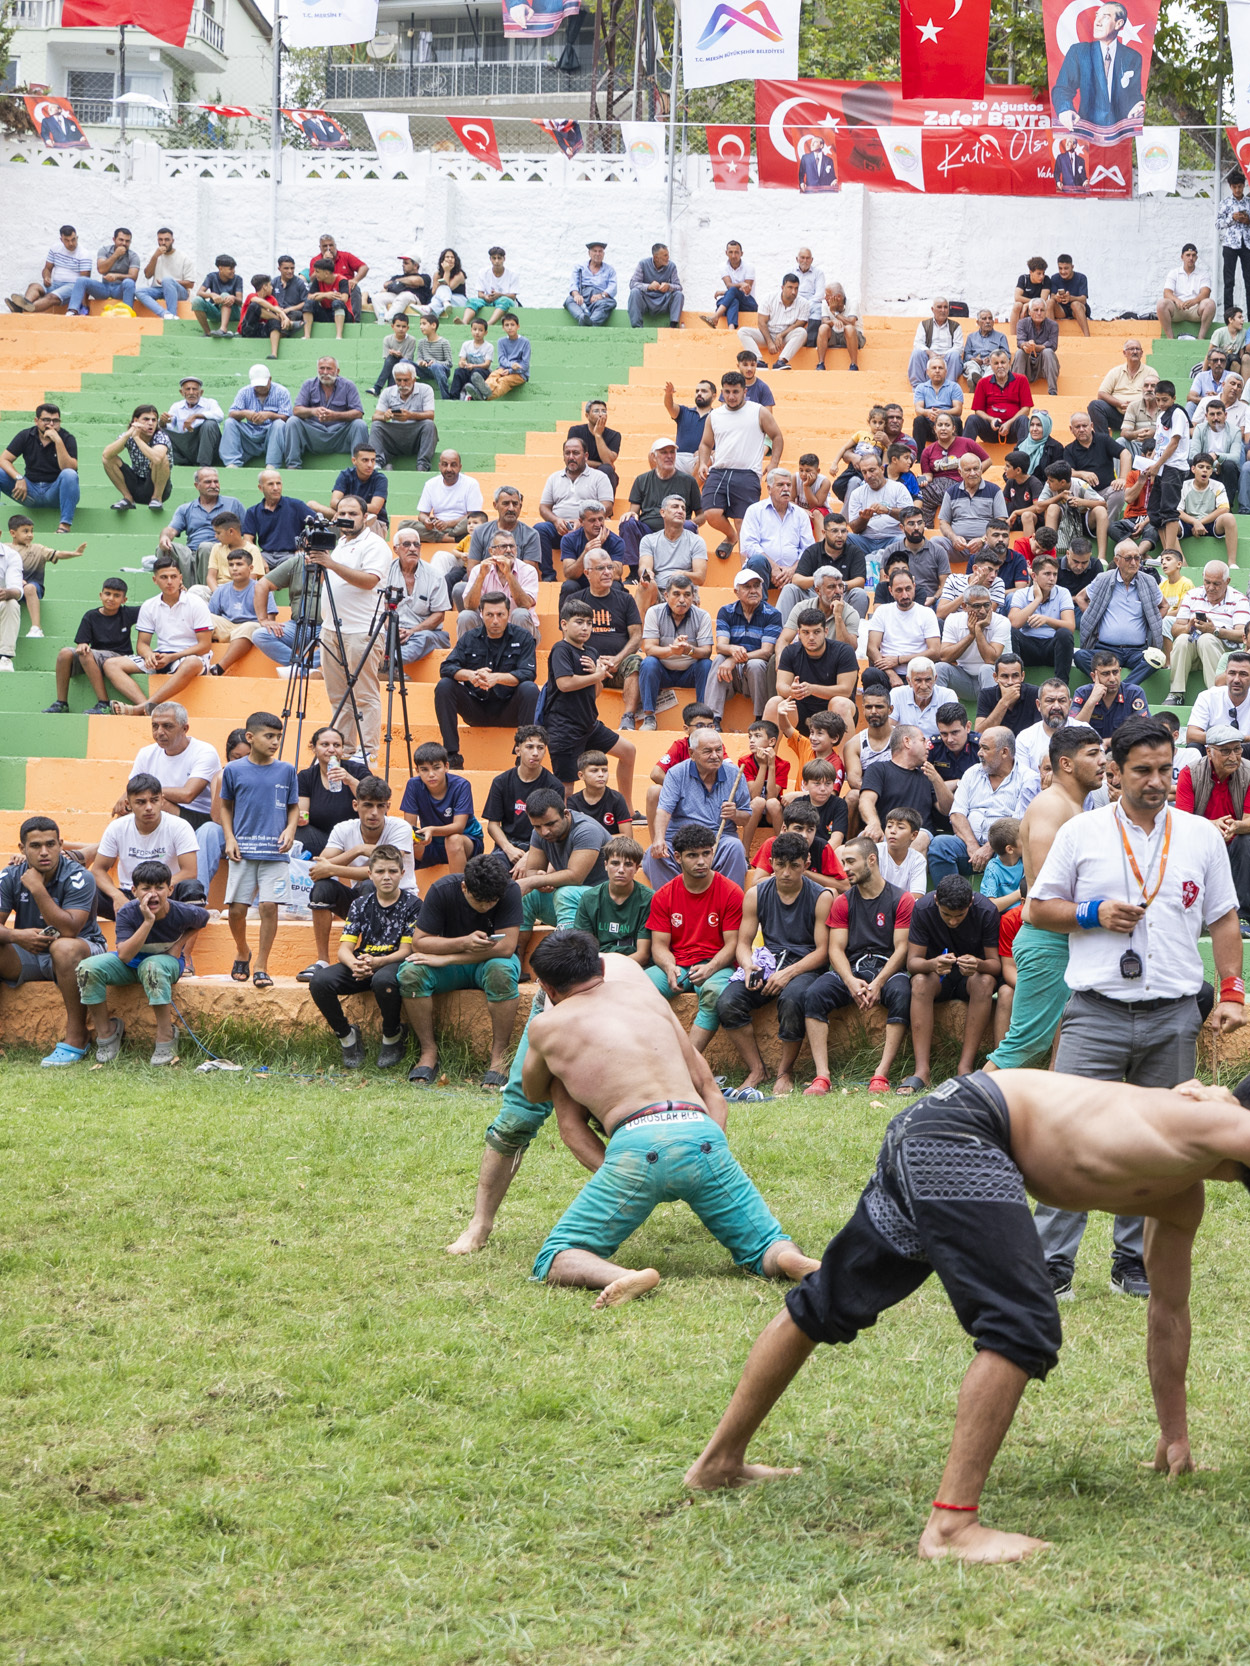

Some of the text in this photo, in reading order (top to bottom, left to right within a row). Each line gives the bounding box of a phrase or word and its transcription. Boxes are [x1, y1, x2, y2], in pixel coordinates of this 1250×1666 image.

[724, 49, 755, 58] BÜYÜKŞEHİR
[972, 101, 1044, 114] 30 Ağustos
[923, 110, 1051, 130] Zafer Bayra
[1010, 129, 1049, 161] Ols
